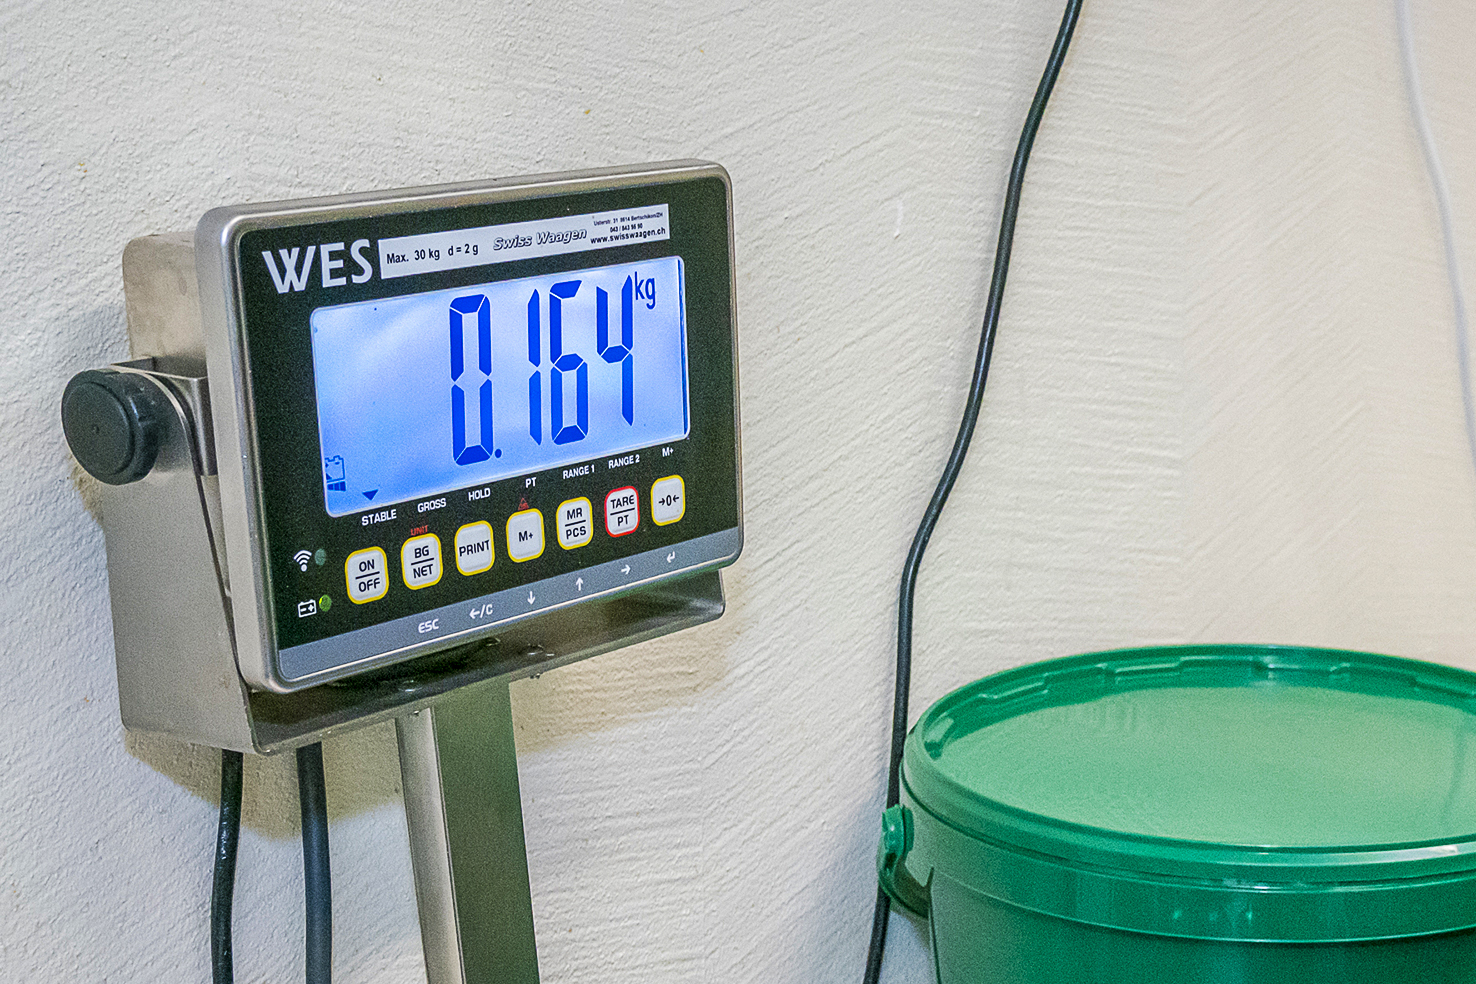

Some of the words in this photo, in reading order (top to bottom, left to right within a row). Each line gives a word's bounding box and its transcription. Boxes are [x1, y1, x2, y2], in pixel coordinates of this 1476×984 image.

[493, 234, 532, 251] Swiss
[535, 228, 588, 245] Waagen
[590, 226, 666, 244] www.swisswaagen.ch
[386, 252, 410, 265] Max.
[414, 249, 426, 261] 30
[428, 247, 440, 260] kg
[447, 245, 454, 257] d
[464, 243, 470, 254] 2
[472, 244, 479, 256] g
[261, 238, 373, 294] WES
[635, 271, 656, 310] kg
[662, 447, 674, 458] M+
[608, 455, 634, 469] RANGE
[635, 454, 640, 463] 2
[562, 465, 590, 479] RANGE
[525, 477, 537, 488] PT
[468, 487, 491, 501] HOLD
[417, 497, 447, 513] GROSS
[610, 494, 635, 510] TARE
[361, 509, 397, 526] STABLE
[566, 507, 583, 521] MR
[617, 514, 630, 527] PT
[410, 525, 428, 536] UNIT
[518, 530, 534, 543] M+
[565, 525, 587, 540] PCS
[414, 545, 430, 559] BG
[458, 540, 490, 557] PRINT
[358, 558, 375, 573] ON
[413, 563, 434, 579] NET
[358, 577, 381, 593] OFF
[418, 618, 440, 634] ESC
